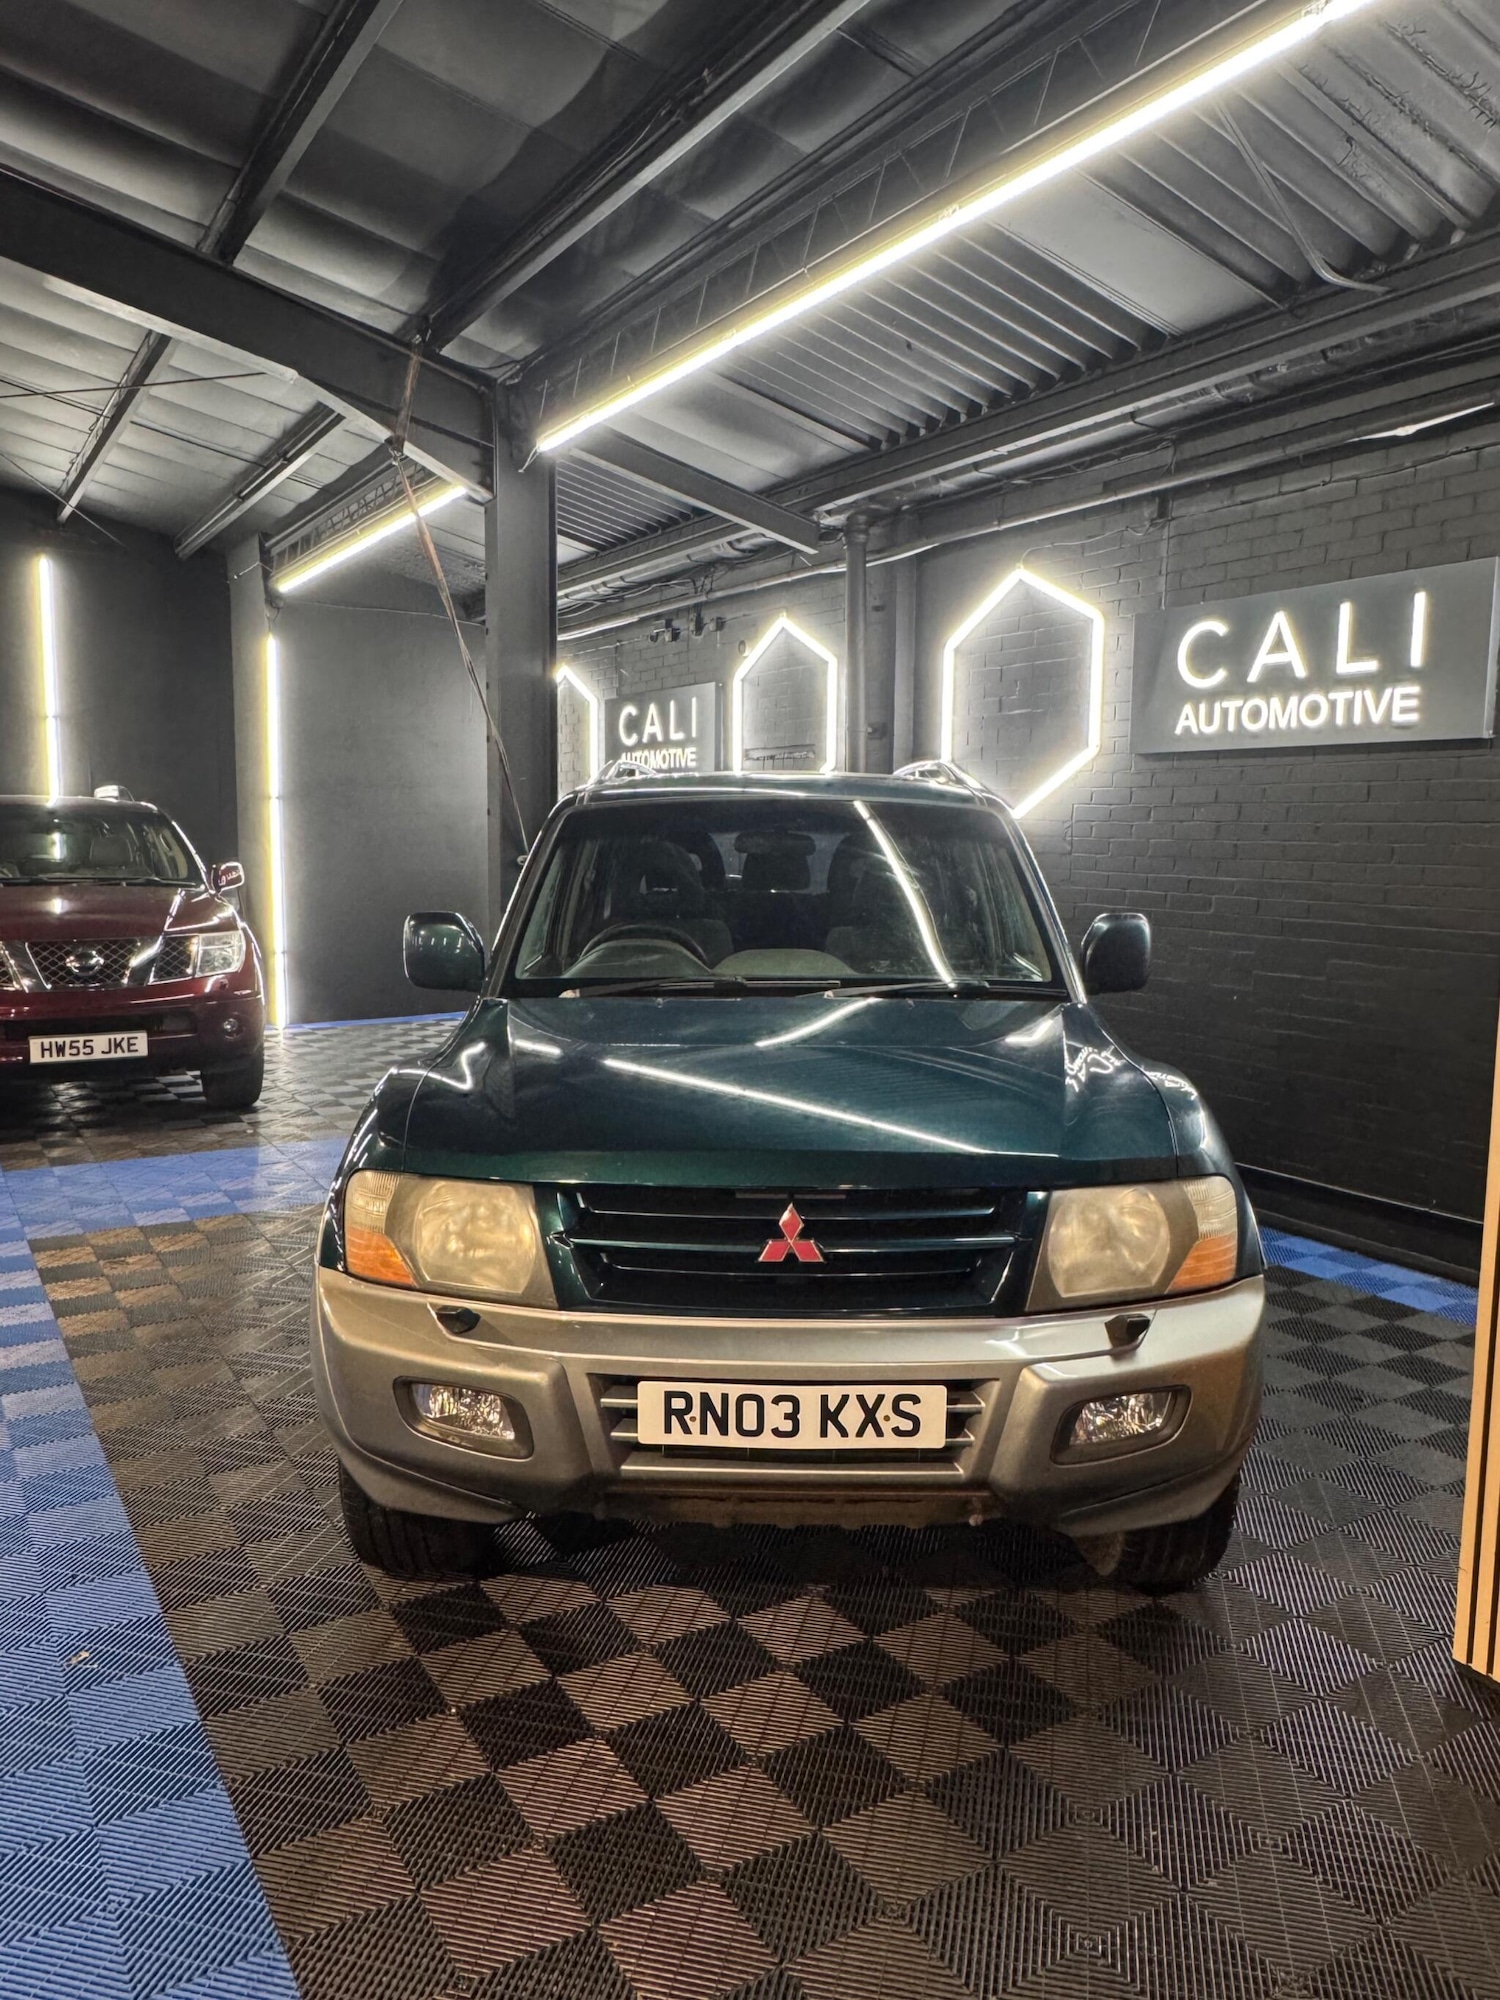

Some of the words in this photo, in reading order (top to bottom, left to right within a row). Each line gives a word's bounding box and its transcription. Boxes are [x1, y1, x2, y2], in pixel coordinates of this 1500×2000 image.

[1176, 590, 1427, 689] CALI
[618, 696, 697, 746] CALI
[1174, 685, 1421, 735] AUTOMOTIVE
[40, 1039, 94, 1059] HW55
[101, 1036, 139, 1055] JKE
[663, 1390, 800, 1439] RN03
[819, 1393, 922, 1439] KXS
